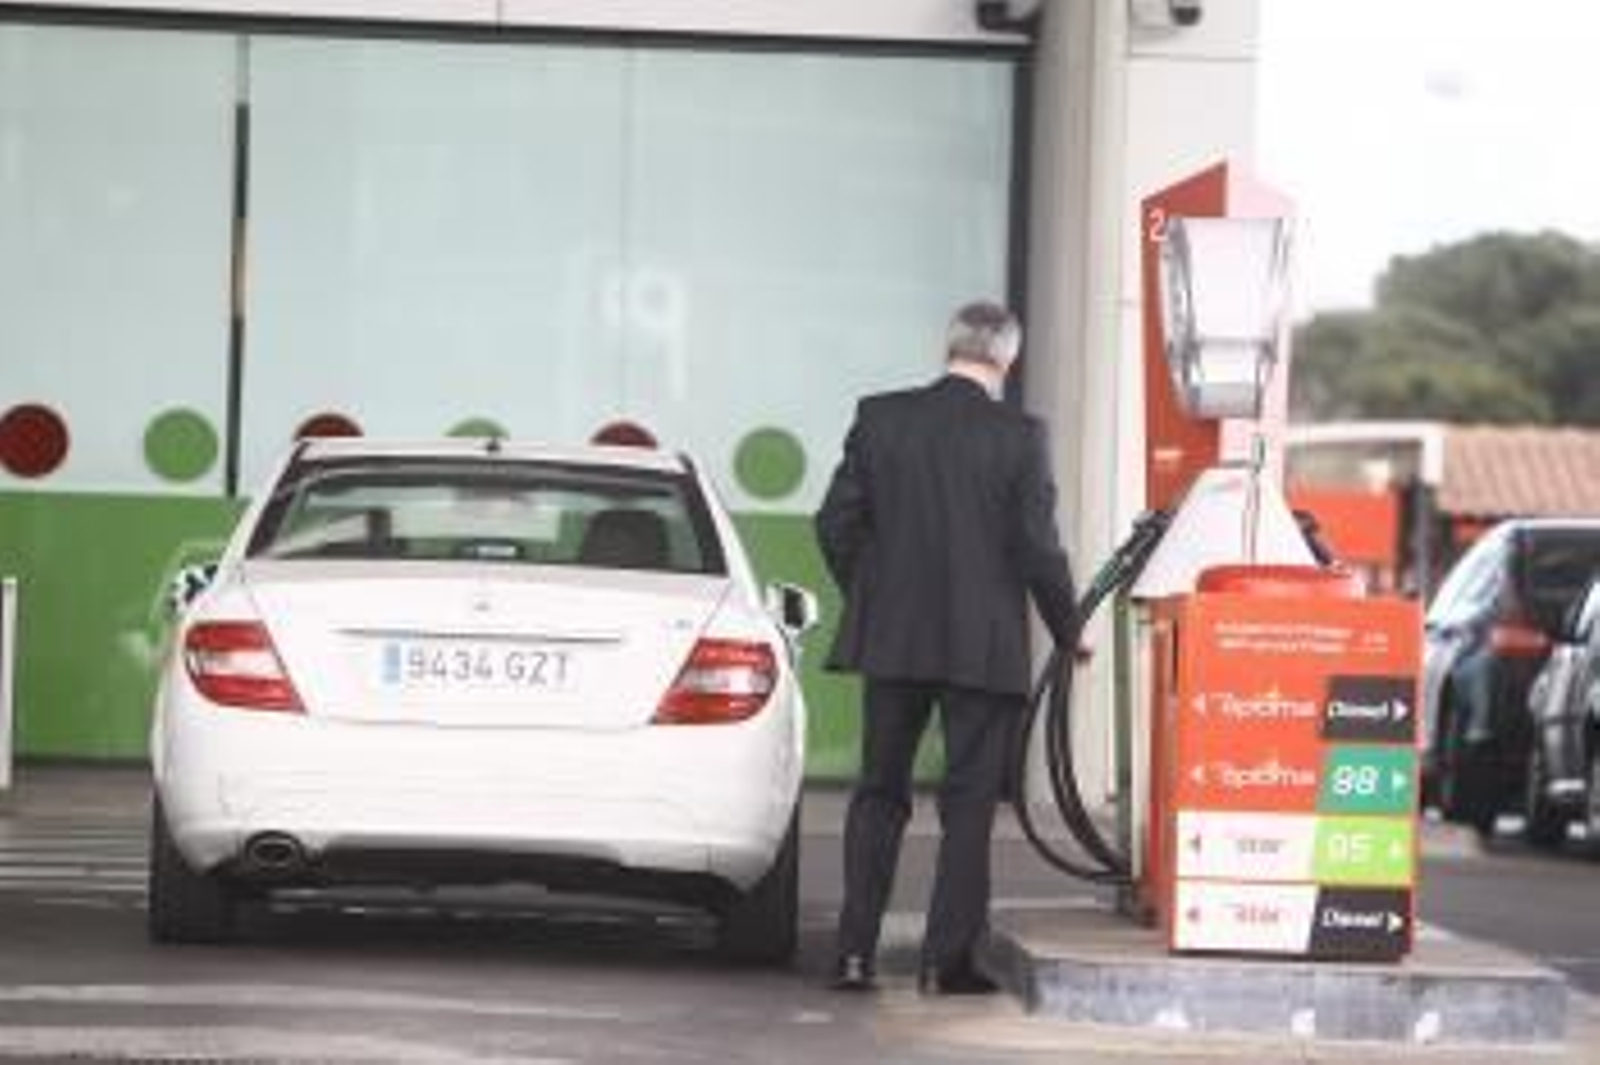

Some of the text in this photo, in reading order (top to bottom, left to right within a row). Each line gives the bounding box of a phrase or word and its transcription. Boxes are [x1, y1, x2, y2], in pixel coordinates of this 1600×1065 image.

[1149, 208, 1168, 241] 2
[407, 648, 571, 684] 9434 GZT
